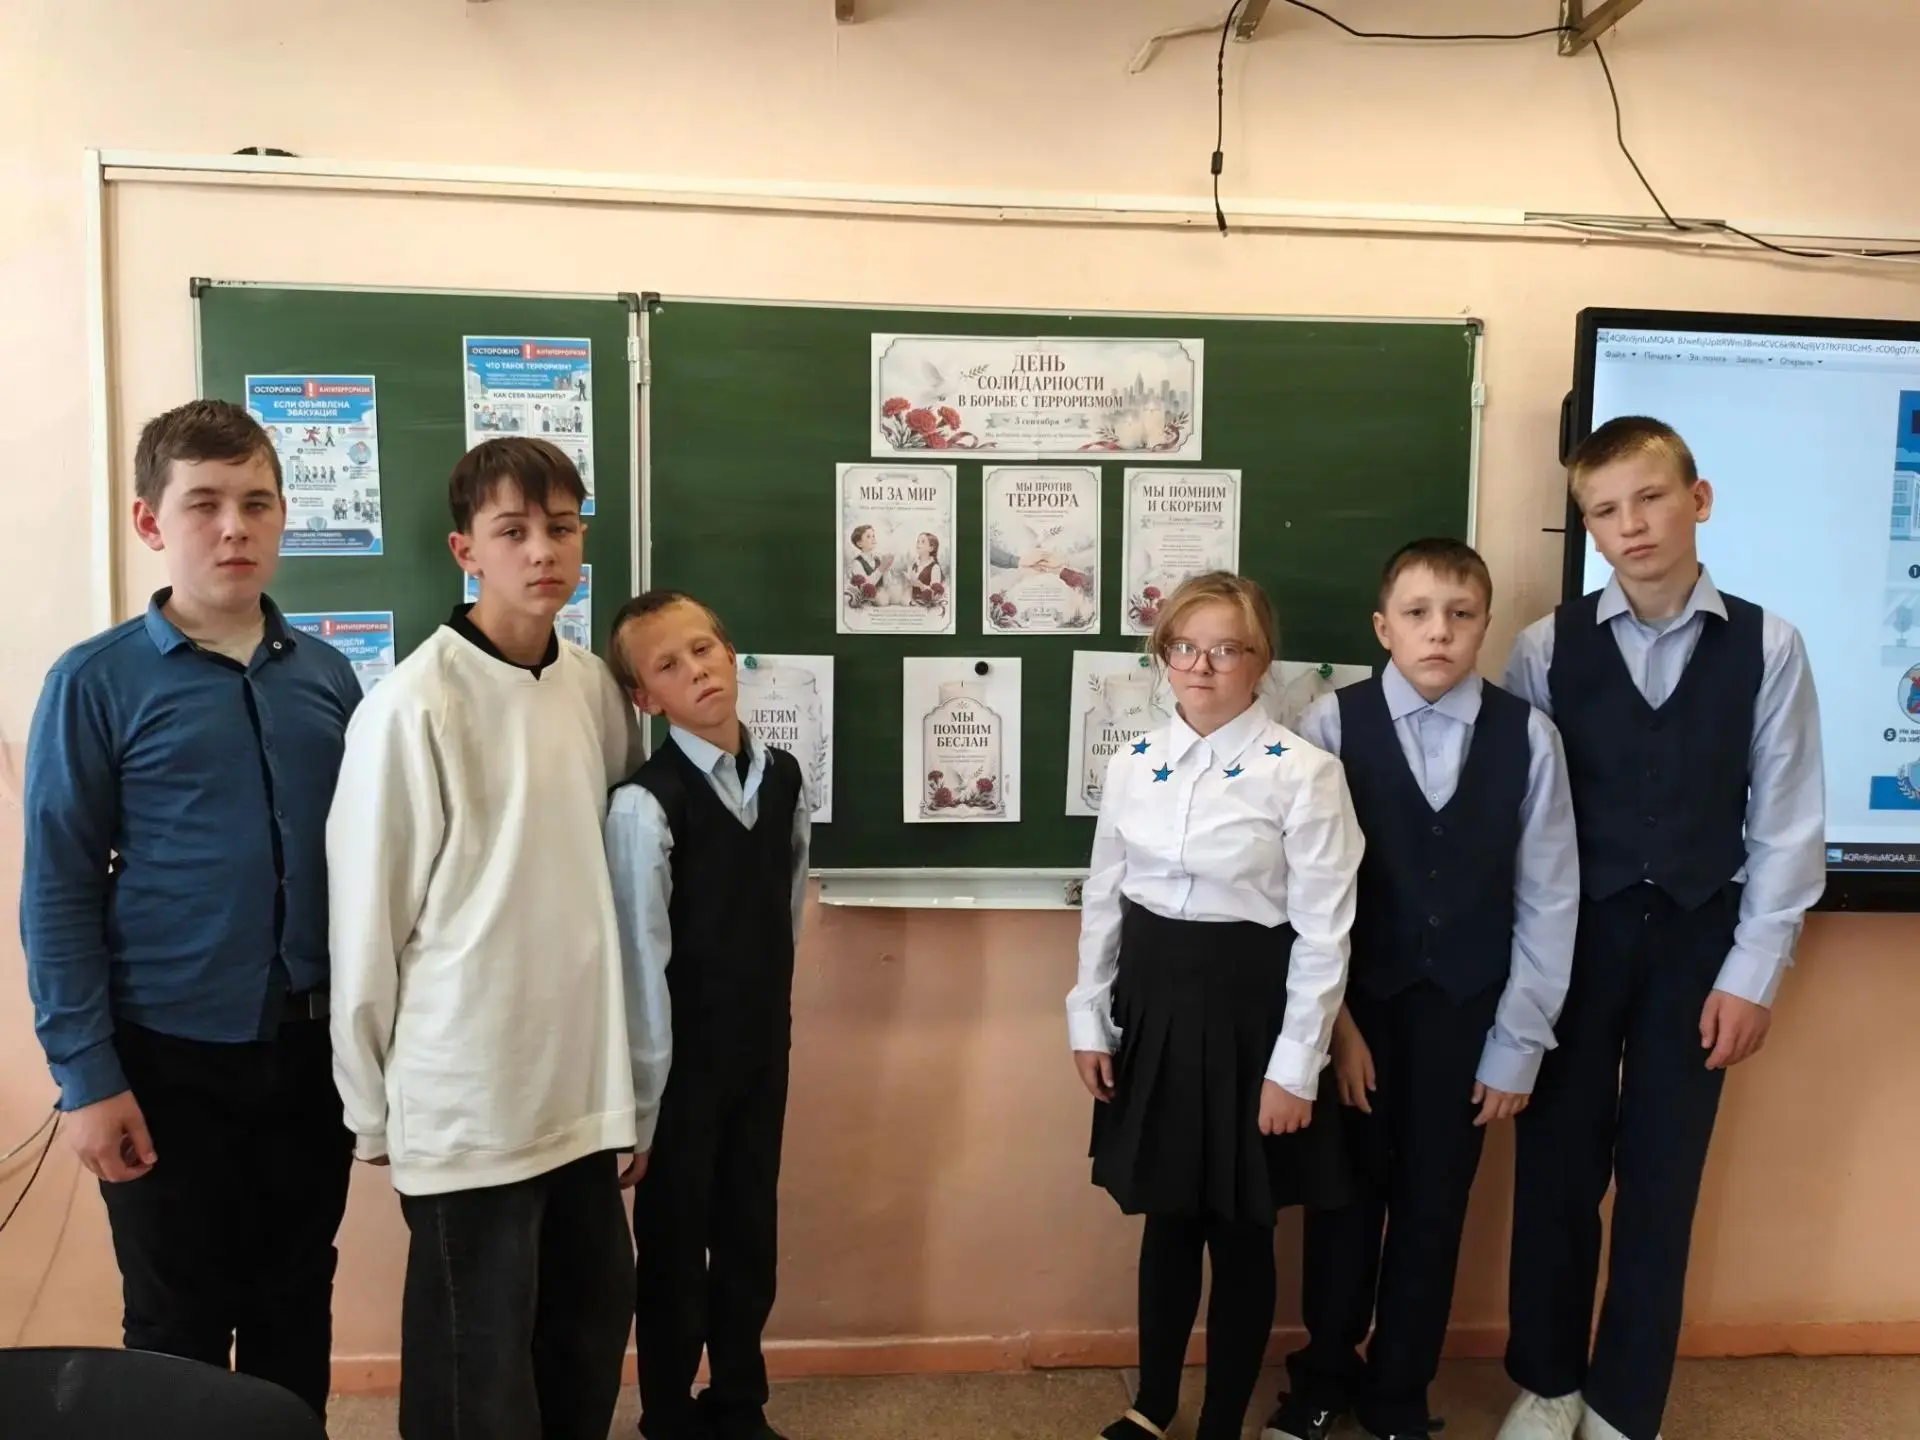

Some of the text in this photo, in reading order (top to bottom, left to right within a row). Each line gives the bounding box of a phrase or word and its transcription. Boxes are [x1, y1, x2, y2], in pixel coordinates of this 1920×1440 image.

[471, 347, 520, 356] ОСТОРОЖНО
[536, 349, 586, 357] АНТИТЕРРОРИЗМ
[485, 362, 572, 371] ЧТО ТАКОЕ ТЕРРОРИЗМ?
[1011, 354, 1066, 375] ДЕНЬ
[254, 383, 302, 394] ОСТОРОЖНО
[319, 385, 371, 394] АНТИТЕРРОРИЗМ
[977, 375, 1104, 393] СОЛИДАРНОСТИ
[493, 392, 566, 401] КАК СЕБЯ ЗАЩИТИТЬ?
[958, 395, 1123, 408] В БОРЬБЕ С ТЕРРОРИЗМОМ
[273, 400, 350, 409] ЕСЛИ ОБЪЯВЛЕНА
[286, 409, 338, 418] ЭВАКУАЦИЯ
[1015, 416, 1059, 426] 3 сентября
[1016, 482, 1072, 492] МЫ ПРОТИВ
[1142, 485, 1226, 499] МЫ ПОМНИМ
[860, 486, 937, 502] МЫ ЗА МИР
[1006, 493, 1079, 508] ТЕРРОРА
[1147, 500, 1222, 513] И СКОРБИМ
[346, 646, 379, 654] ПРЕДМЕТ
[749, 709, 797, 724] ДЕТЯМ
[950, 711, 974, 723] МЫ
[933, 724, 991, 736] ПОМНИМ
[936, 736, 988, 748] БЕСЛАН
